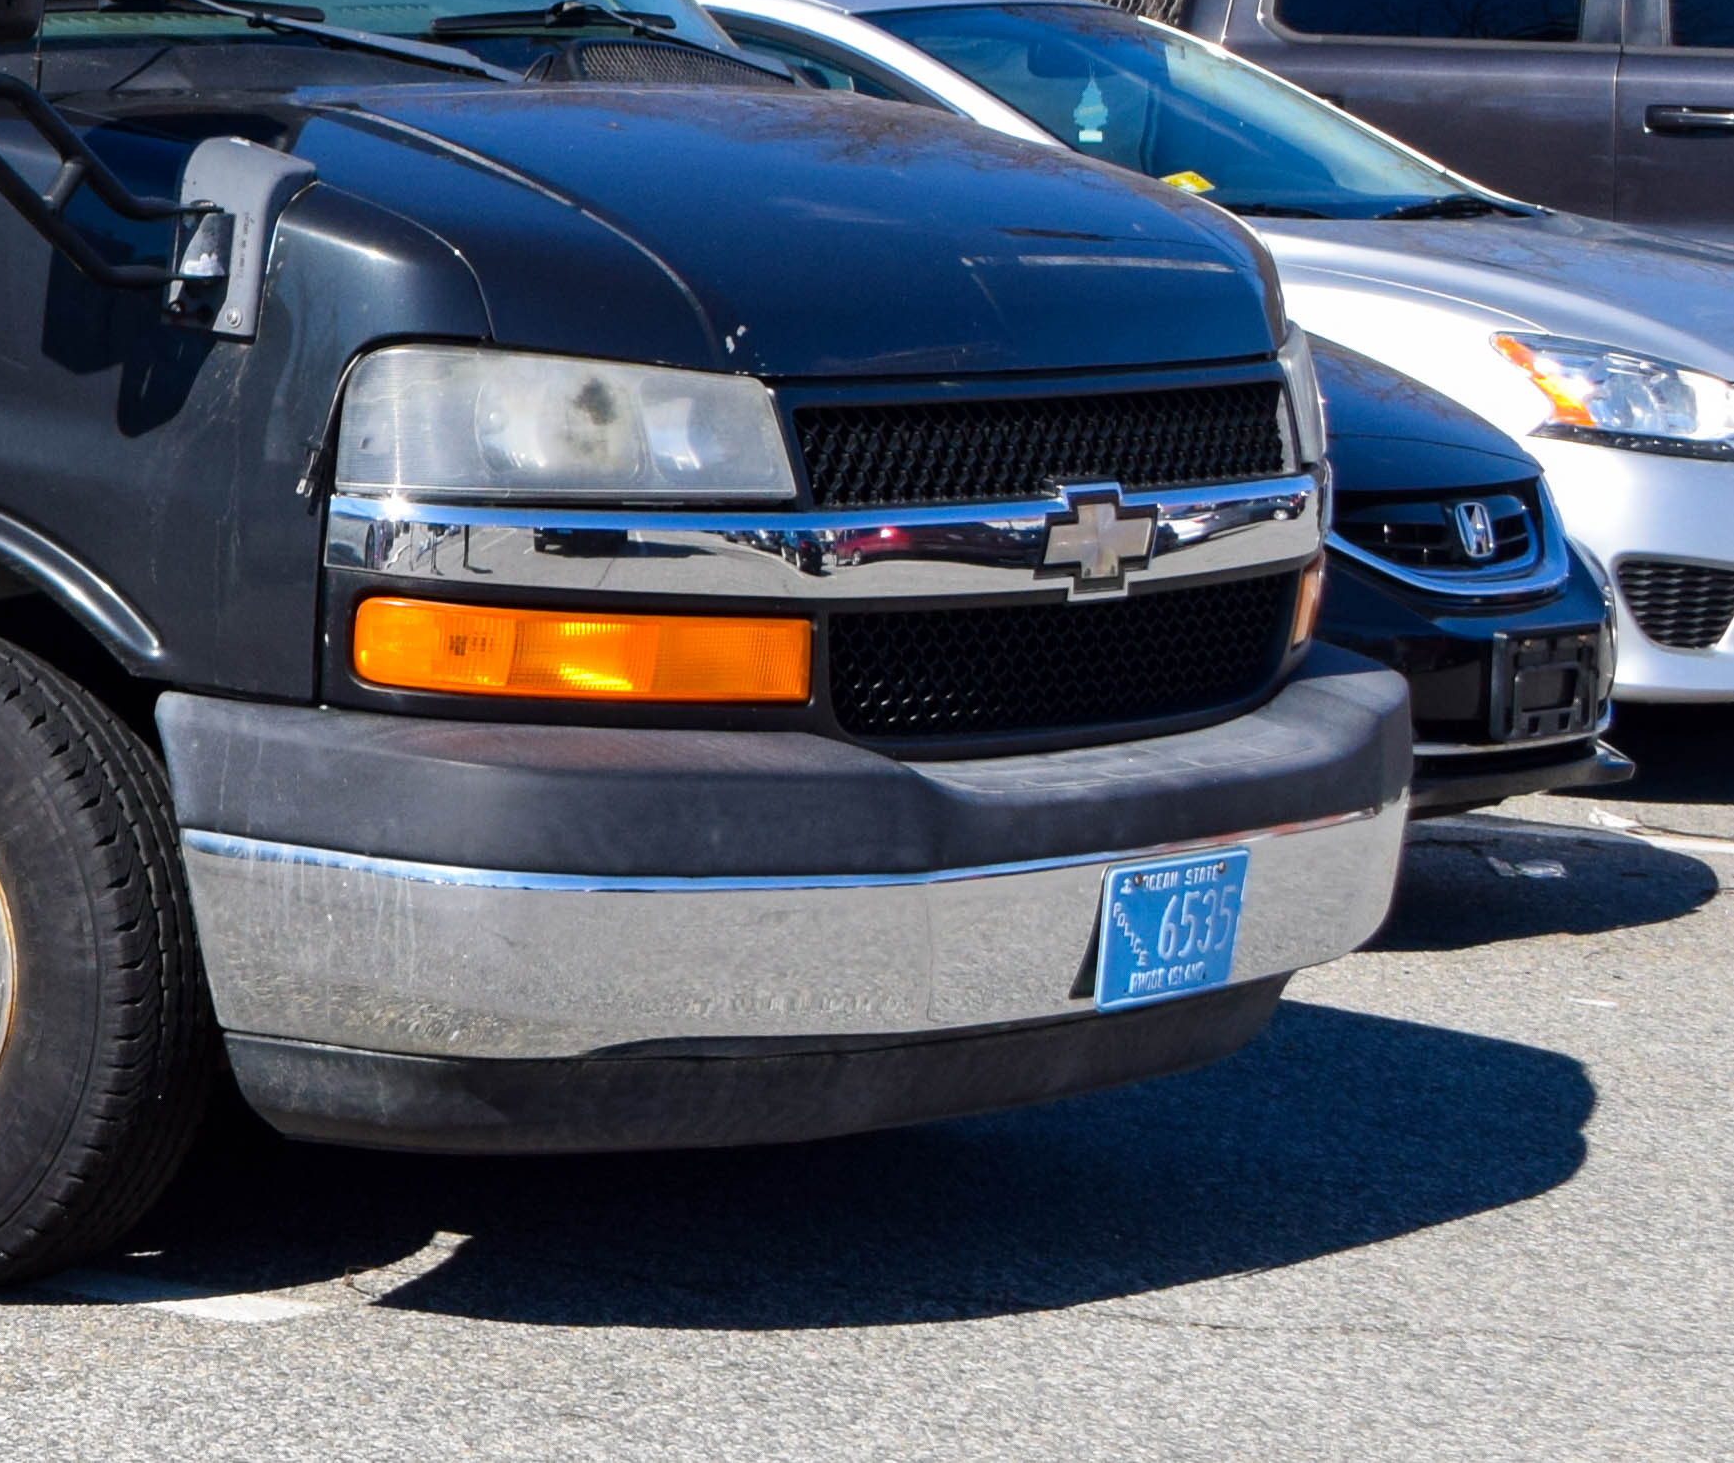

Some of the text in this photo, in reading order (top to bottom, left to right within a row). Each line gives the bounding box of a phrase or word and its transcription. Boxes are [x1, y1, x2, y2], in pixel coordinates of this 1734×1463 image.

[1184, 864, 1219, 886] STATE
[1112, 902, 1149, 967] POLICE
[1158, 885, 1238, 961] 6535
